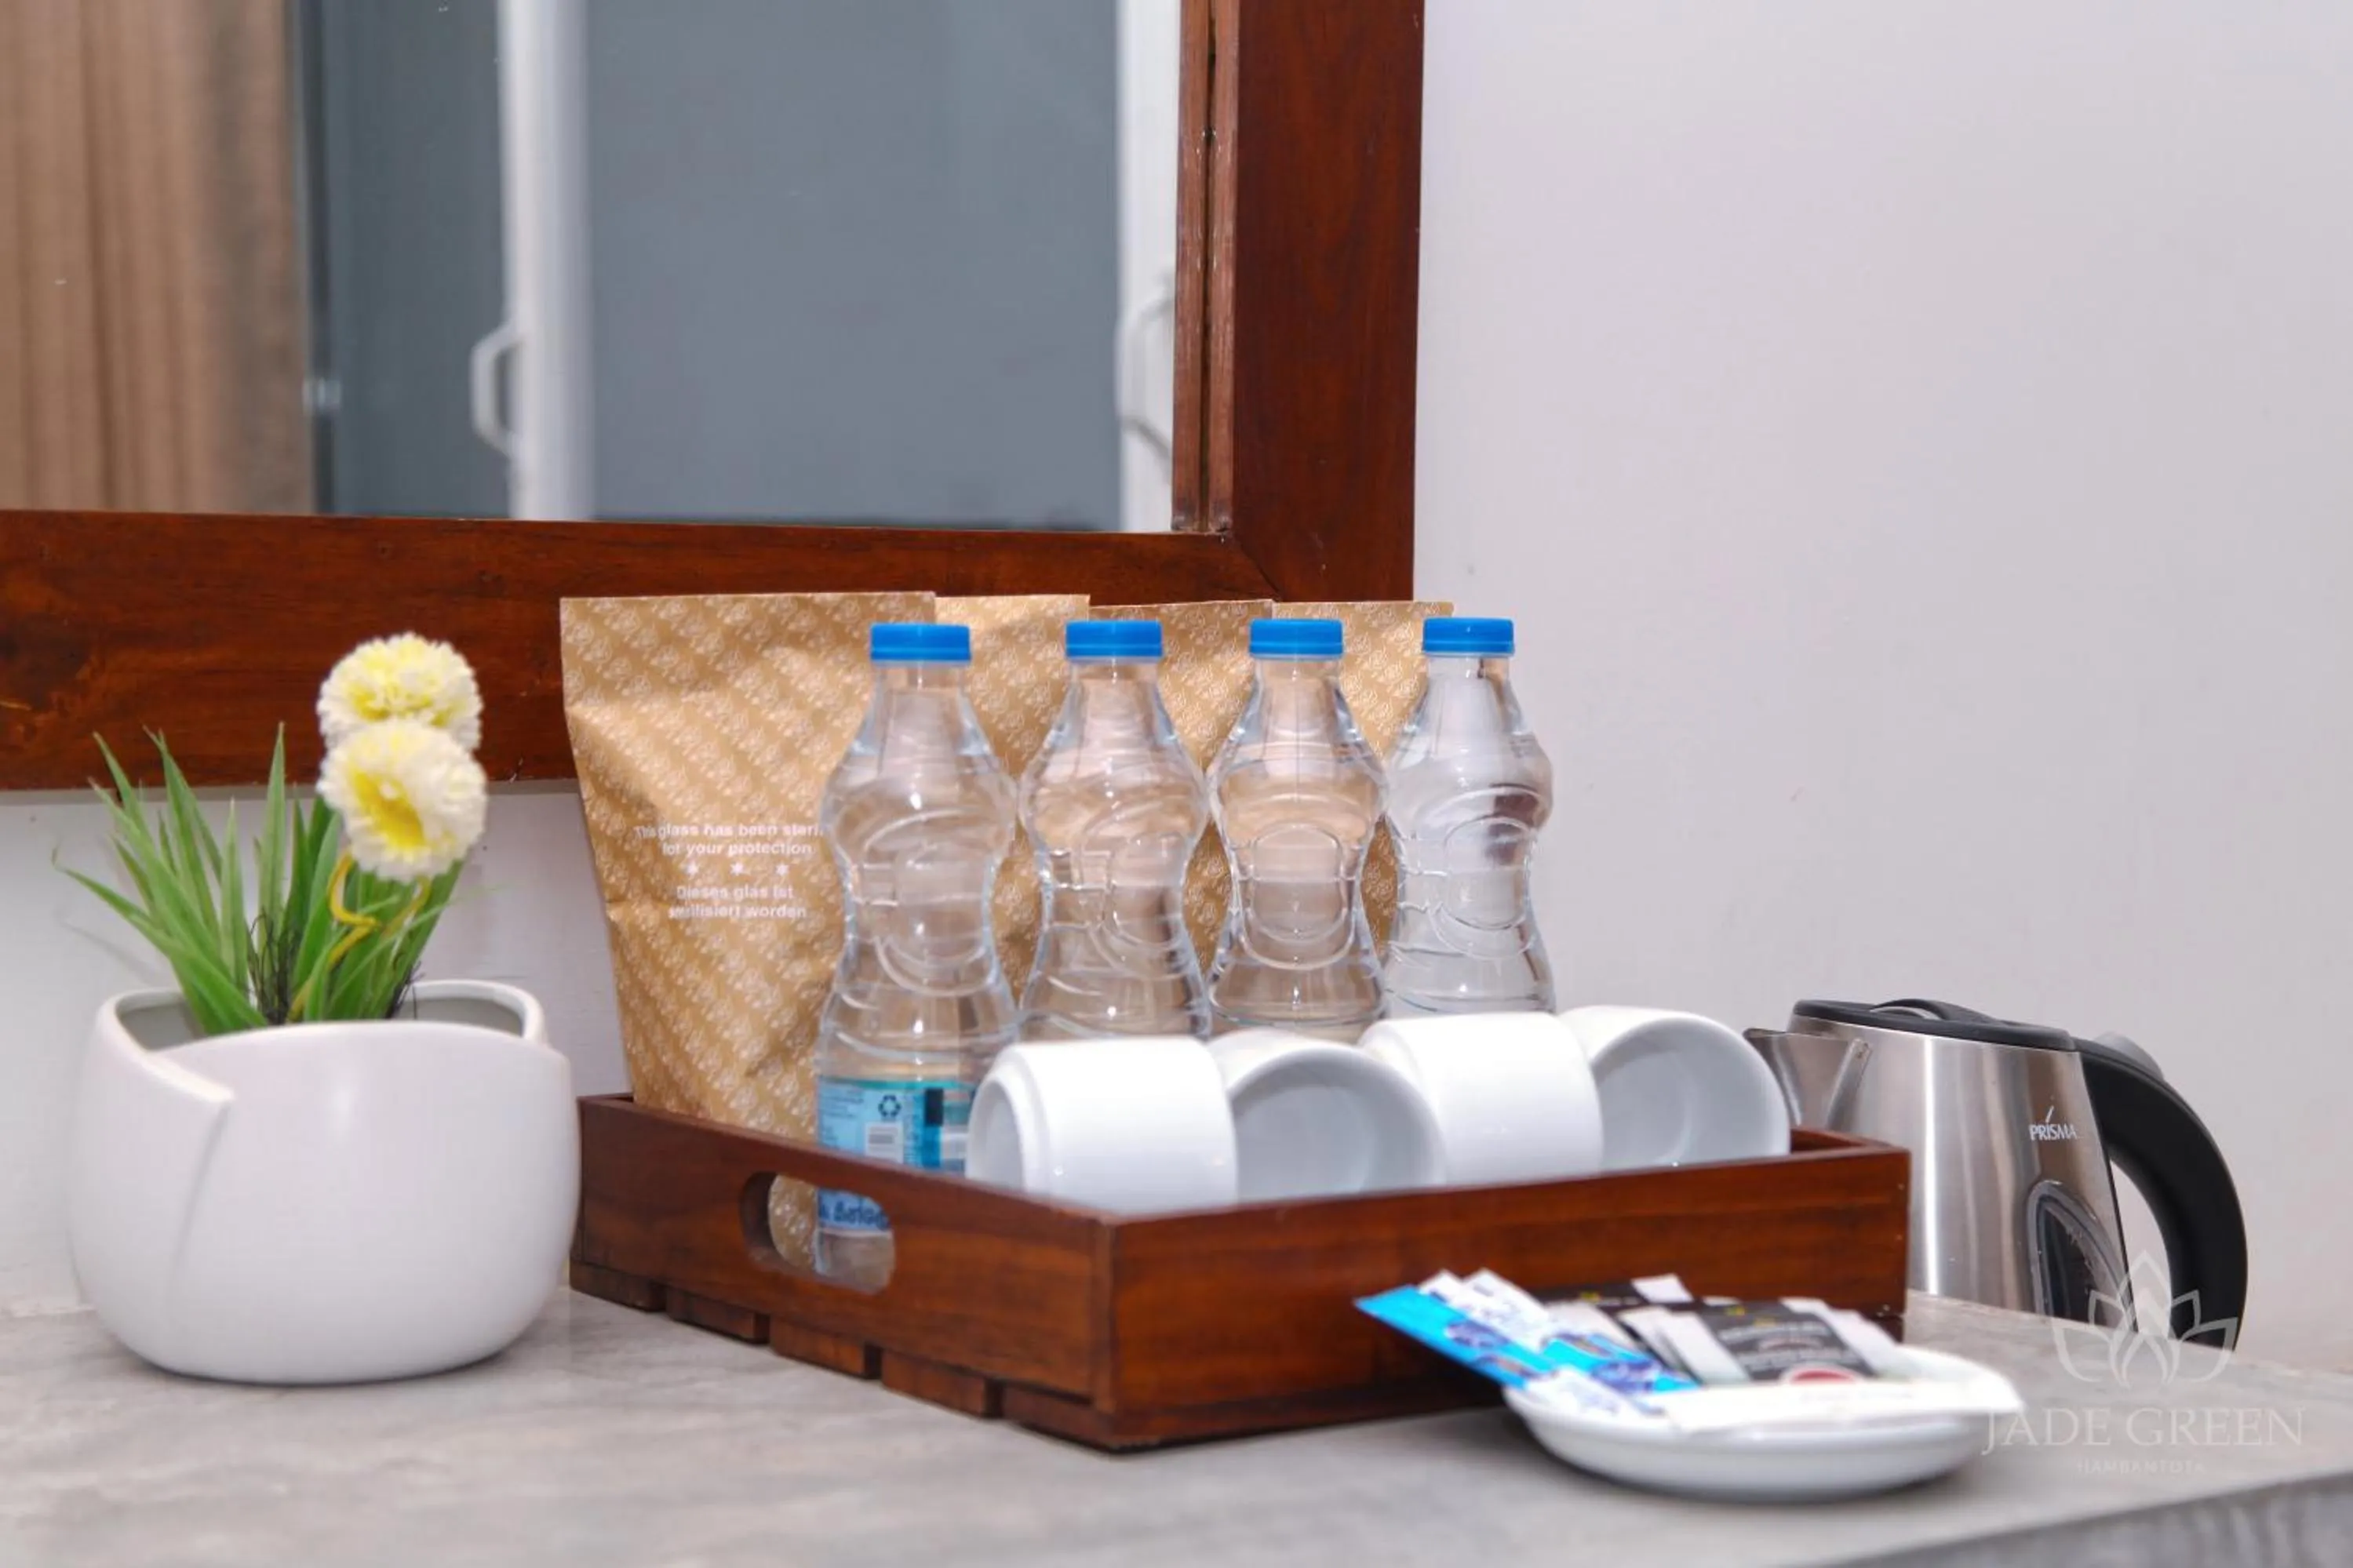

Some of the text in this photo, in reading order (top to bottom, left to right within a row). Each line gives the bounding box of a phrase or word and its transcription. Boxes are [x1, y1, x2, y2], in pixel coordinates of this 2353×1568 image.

[658, 823, 698, 841] glass
[704, 824, 733, 836] has
[739, 824, 777, 836] been
[662, 842, 812, 858] for your protection
[677, 884, 793, 902] Dieses glas ist
[744, 904, 806, 918] worden
